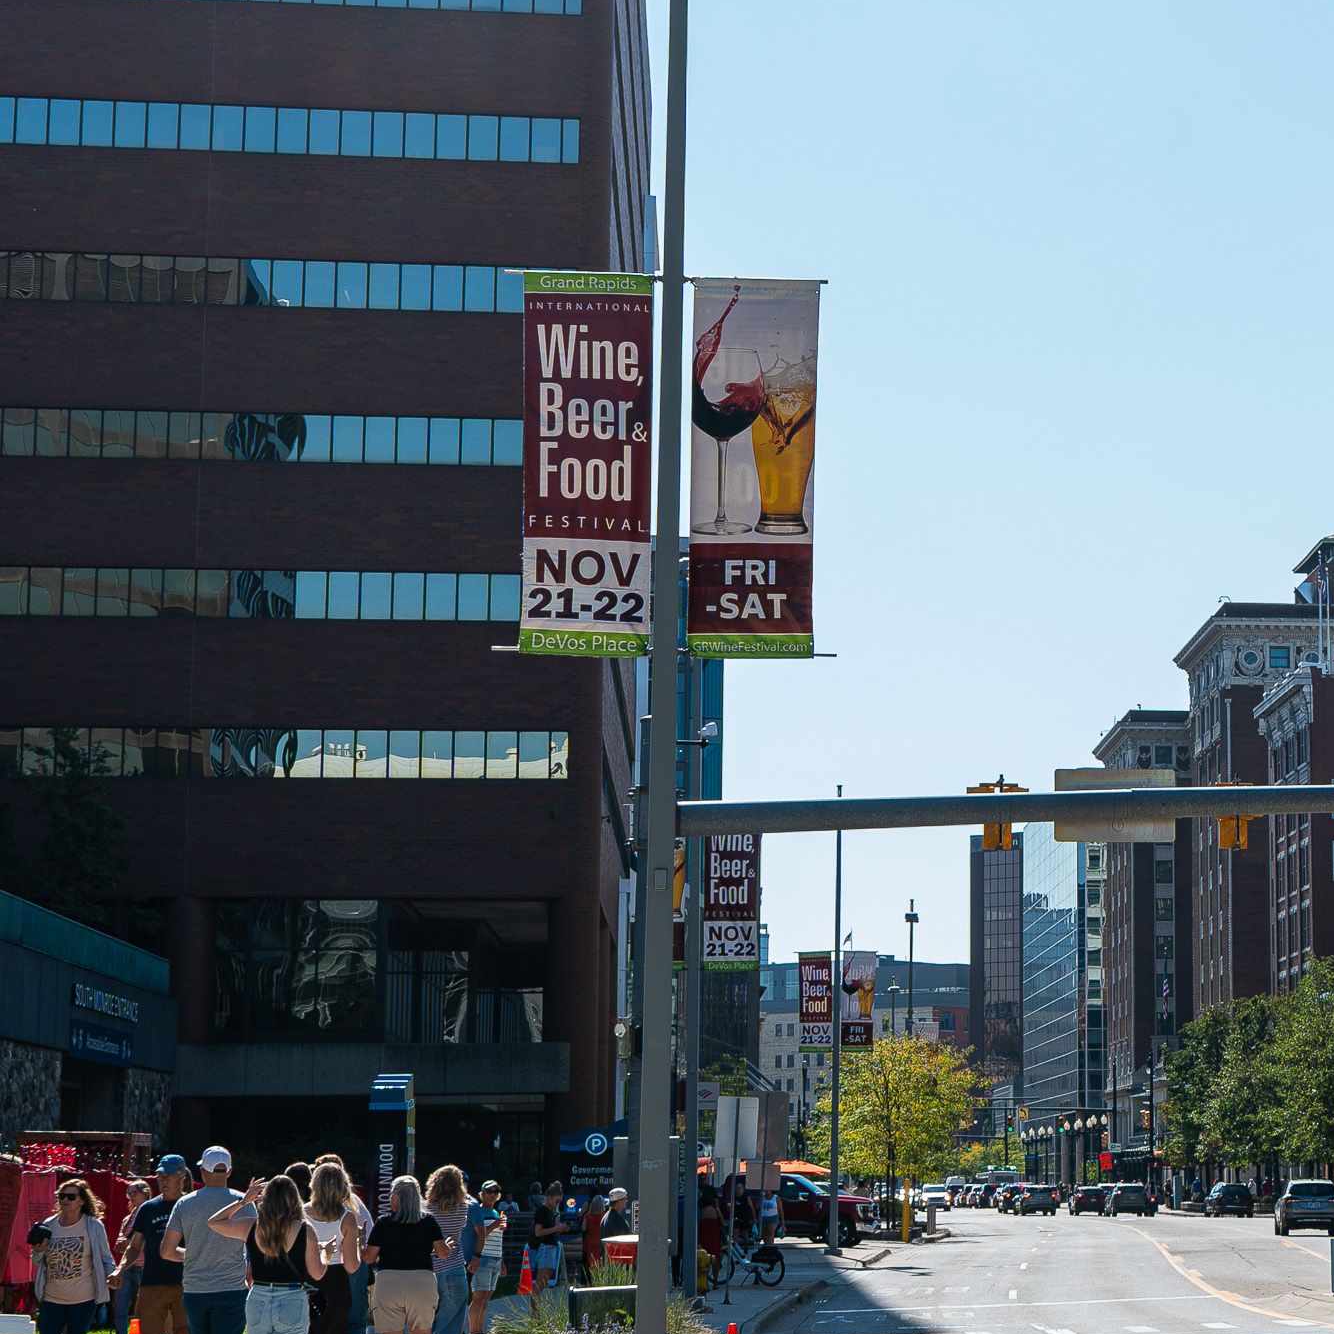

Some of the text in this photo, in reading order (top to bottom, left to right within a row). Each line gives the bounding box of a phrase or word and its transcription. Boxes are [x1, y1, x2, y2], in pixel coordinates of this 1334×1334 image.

[540, 275, 637, 291] Grand Rapids
[529, 302, 650, 313] INTERNATIONAL
[537, 324, 644, 387] Wine,
[540, 383, 633, 441] Beer
[539, 442, 632, 502] Food
[529, 515, 643, 533] FESTIVAL
[535, 549, 641, 587] NOV
[724, 559, 776, 585] FRI
[528, 588, 644, 623] 21-22
[706, 593, 787, 619] -SAT
[531, 633, 637, 652] DeVos Place
[692, 640, 808, 654] GRWineFestival.com
[711, 833, 755, 854] Wine,
[710, 852, 749, 878] Beer
[710, 879, 748, 905] Food
[708, 925, 753, 942] NOV
[706, 942, 756, 957] 21-22
[708, 962, 754, 970] DeVos Place
[802, 965, 830, 982] Wine,
[803, 982, 827, 997] Beer
[803, 997, 828, 1013] Food
[802, 1025, 830, 1036] NOV
[849, 1026, 864, 1034] FRI
[801, 1035, 831, 1044] 21-22
[572, 1165, 614, 1175] Governme
[379, 1143, 393, 1216] DOWNTOW
[570, 1177, 597, 1185] Center
